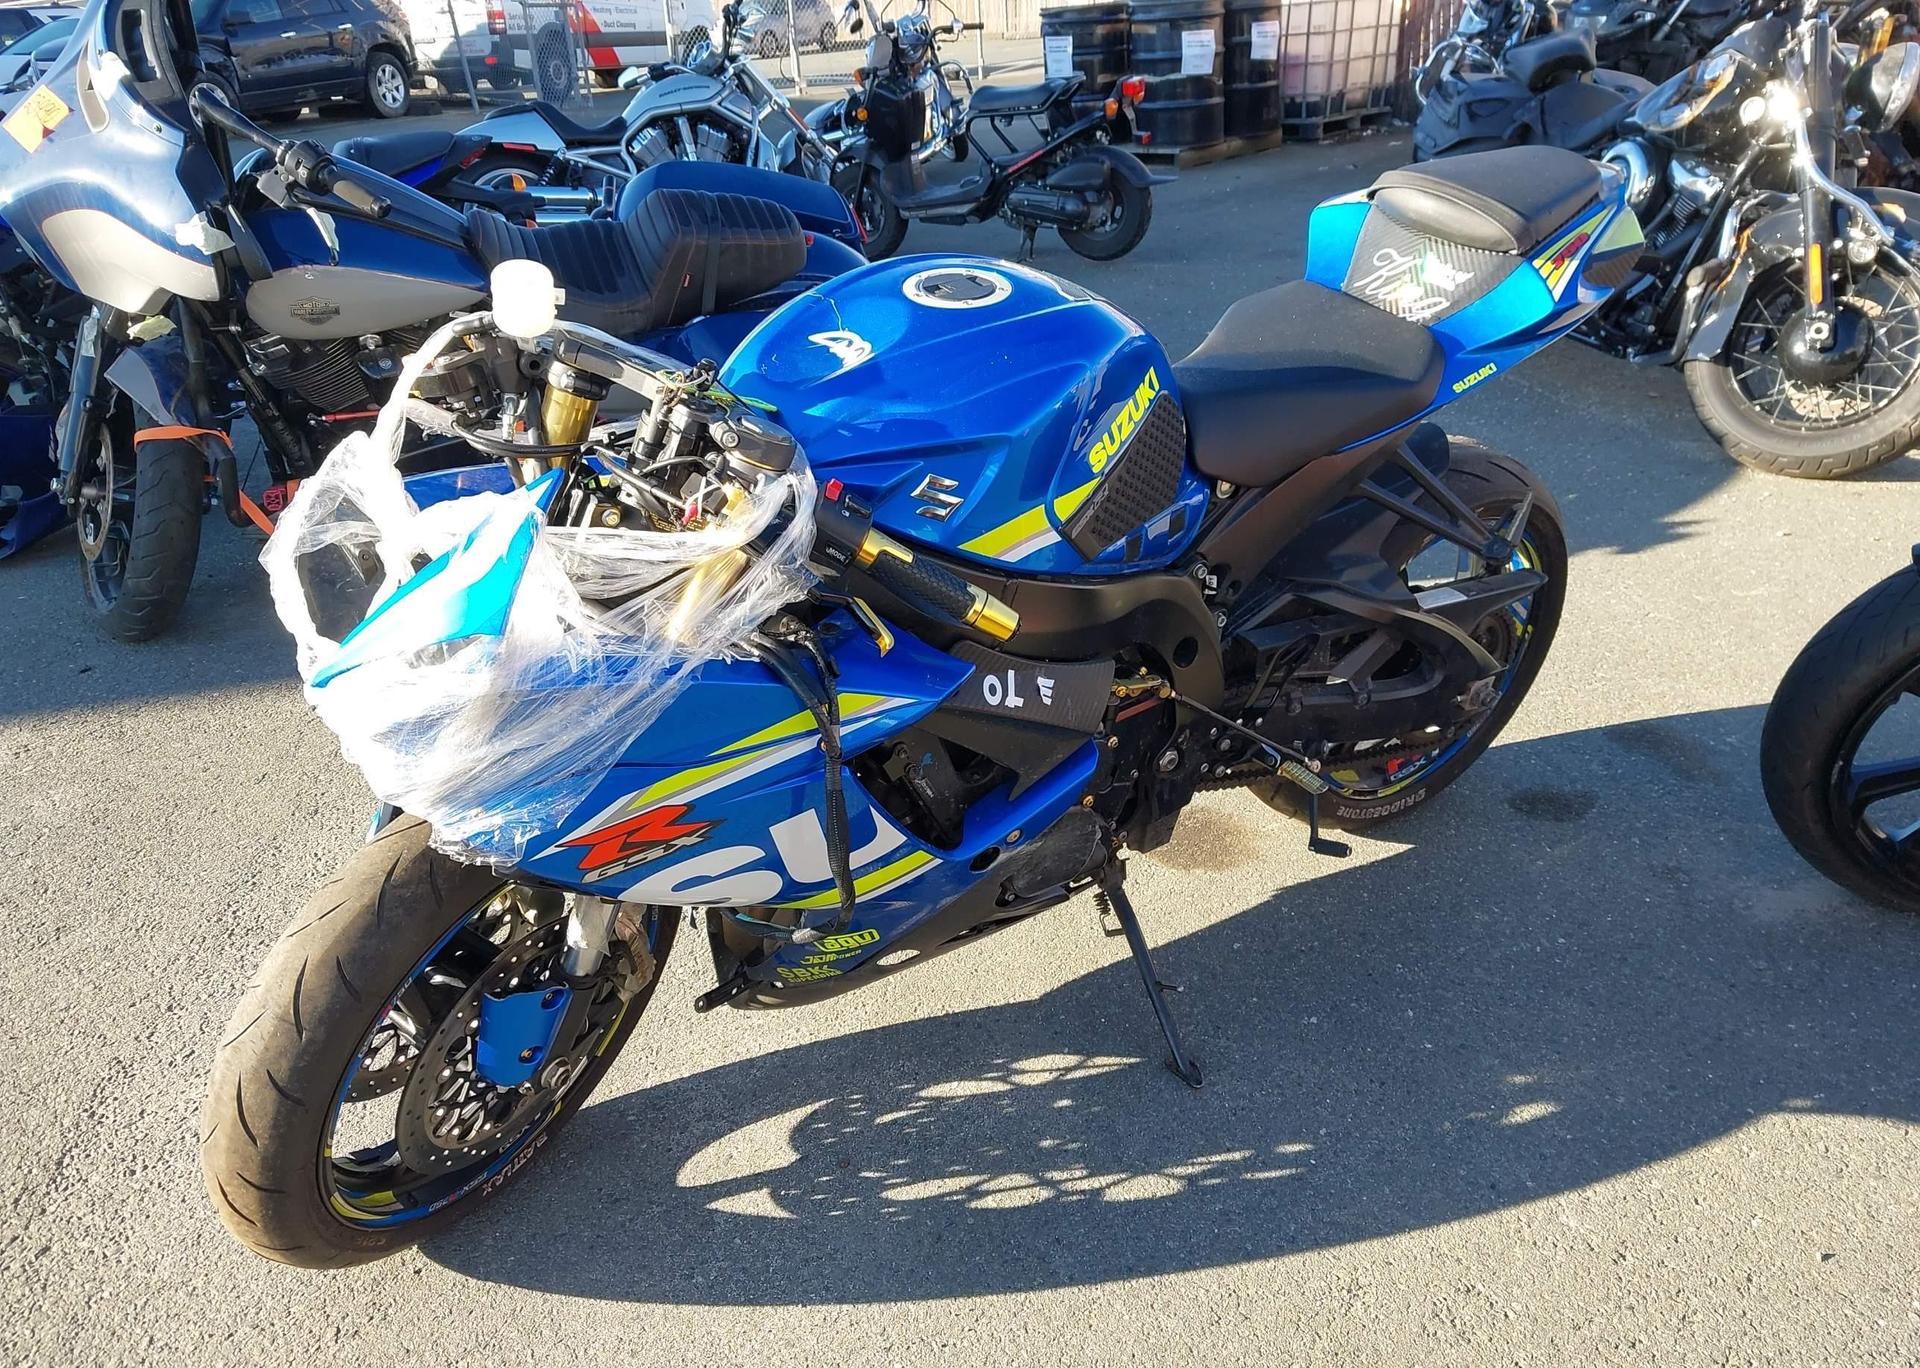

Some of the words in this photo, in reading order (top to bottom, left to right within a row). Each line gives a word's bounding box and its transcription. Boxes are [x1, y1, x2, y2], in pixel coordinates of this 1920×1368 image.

[603, 20, 615, 28] Duct
[616, 20, 637, 30] Cleaning
[1451, 361, 1498, 394] SUZUKI
[1088, 365, 1161, 474] SUZUKI
[581, 825, 714, 885] GSX
[481, 1132, 548, 1197] BATTLAX
